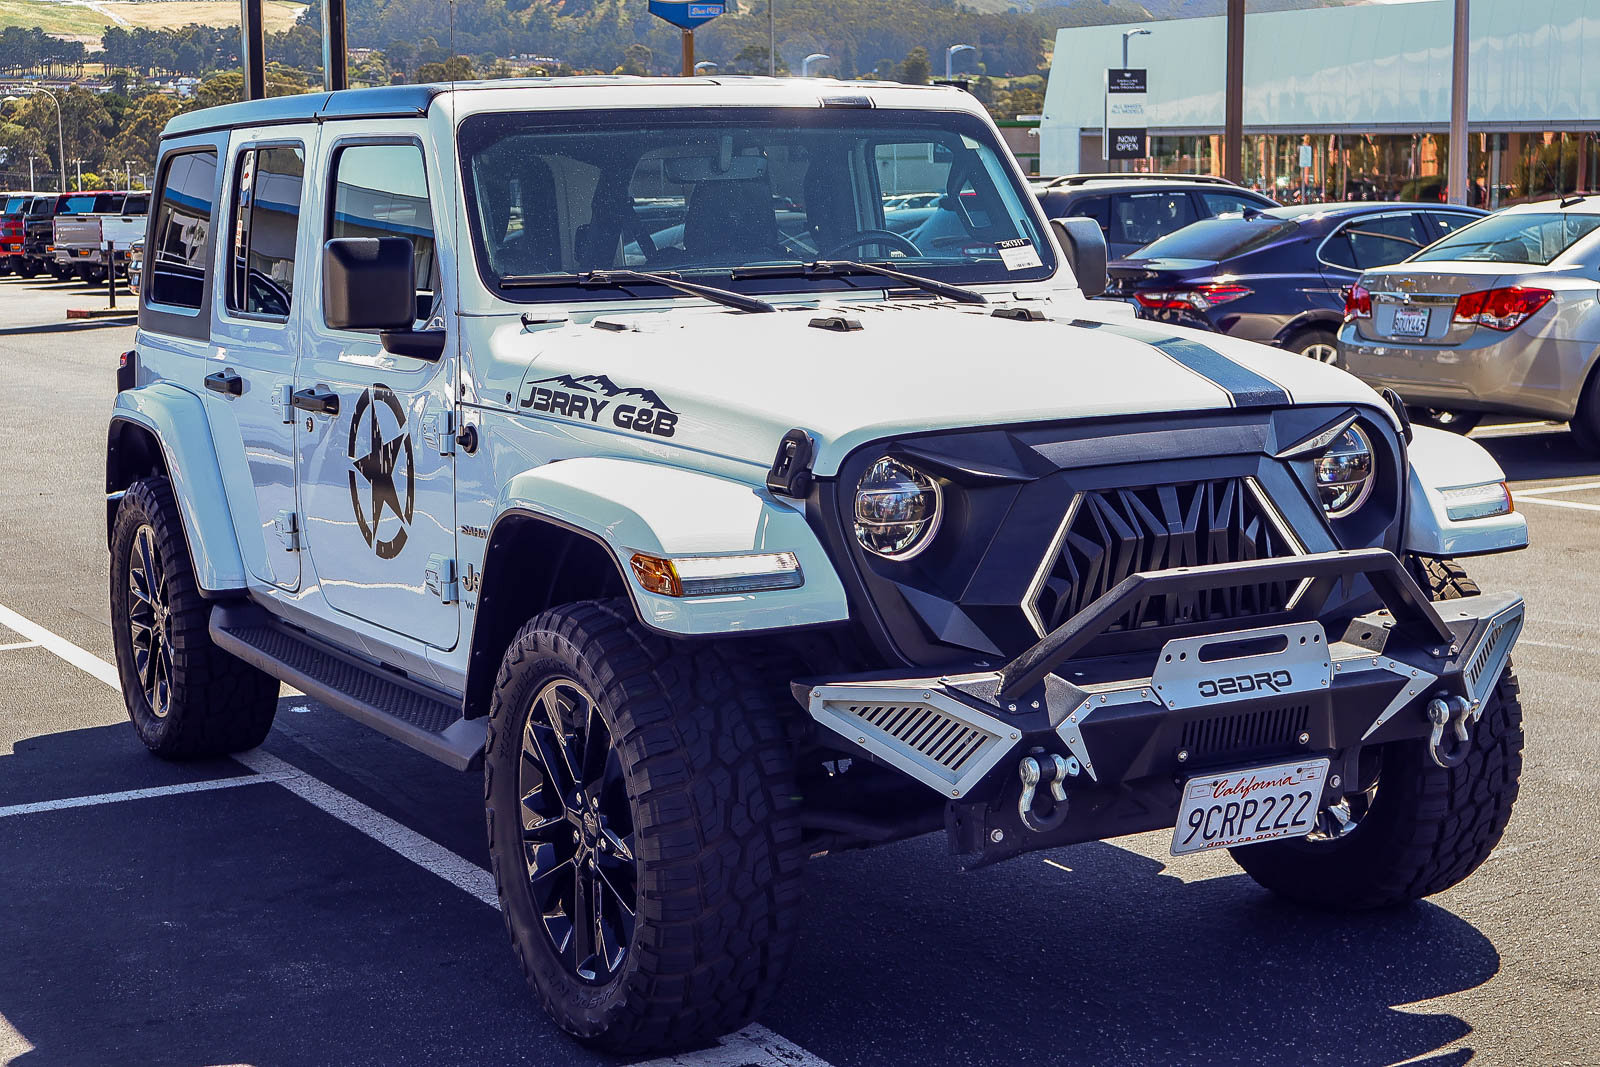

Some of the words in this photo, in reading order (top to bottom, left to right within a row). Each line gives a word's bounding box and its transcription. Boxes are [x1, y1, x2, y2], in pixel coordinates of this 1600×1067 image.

[1115, 143, 1138, 151] OPEN
[1117, 135, 1137, 143] NOW
[612, 403, 679, 438] G&B
[461, 525, 488, 539] SAHA
[1213, 775, 1301, 800] California
[1182, 790, 1313, 845] 9CRP222
